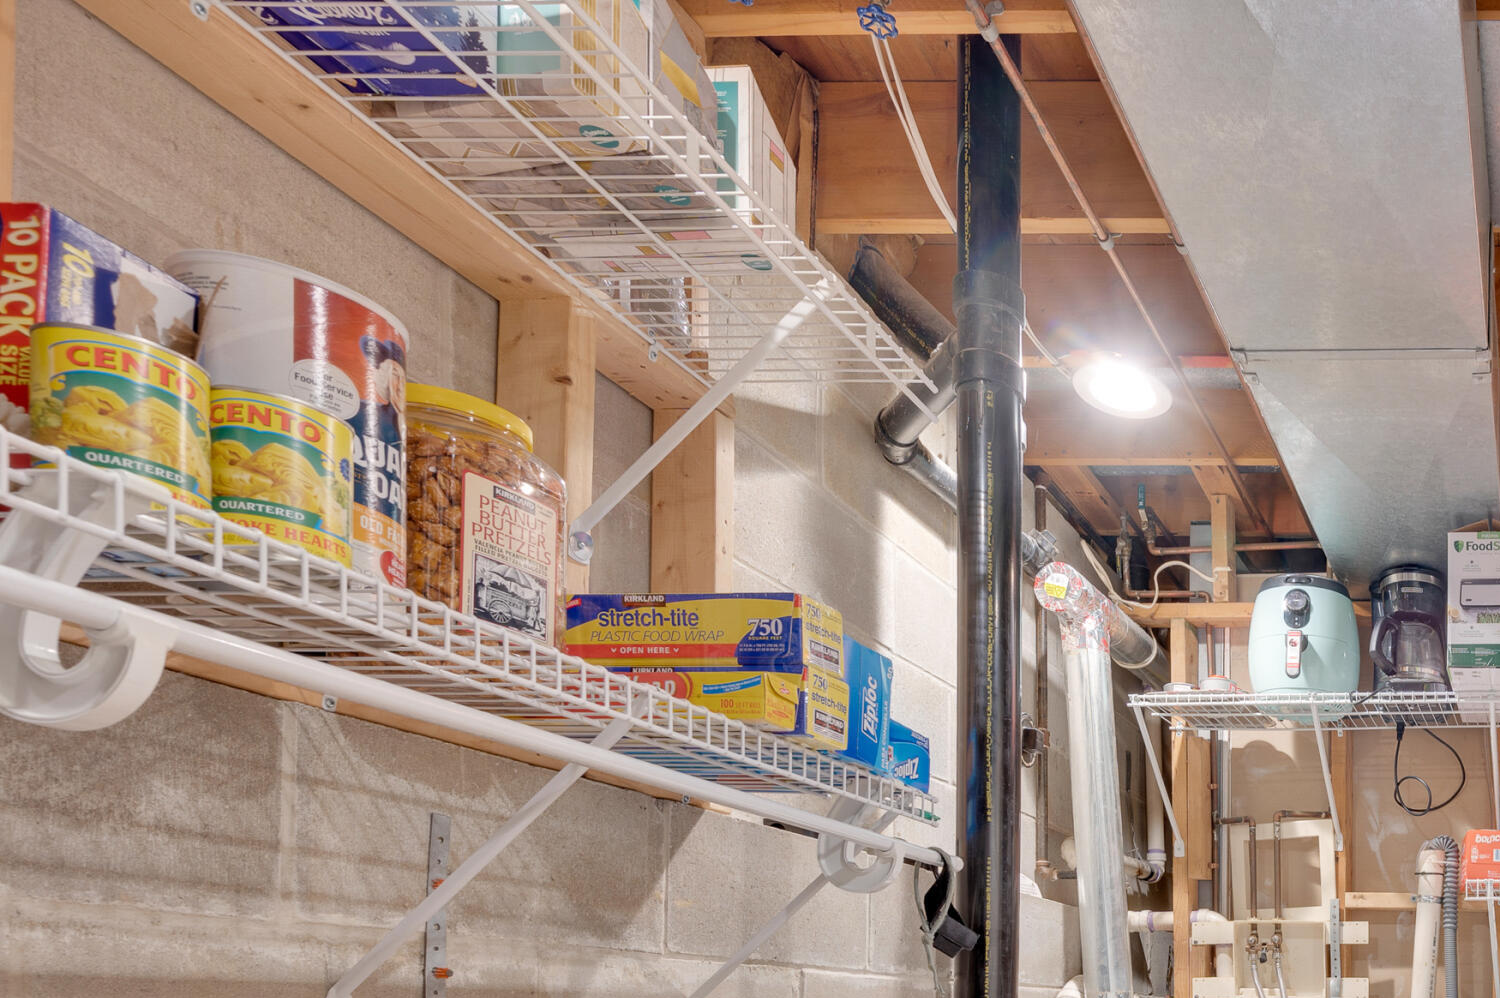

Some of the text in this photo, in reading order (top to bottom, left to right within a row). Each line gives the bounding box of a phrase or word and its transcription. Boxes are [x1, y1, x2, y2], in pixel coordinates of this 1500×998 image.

[0, 215, 40, 342] 10 PACK
[0, 345, 17, 386] SIZE
[66, 345, 196, 400] CENTO
[210, 403, 321, 443] CENTO
[85, 451, 184, 485] QUARTERED
[219, 499, 305, 522] QUARTERED
[494, 487, 536, 511] KIRKLAND
[479, 495, 547, 532] PEANUT
[479, 511, 547, 549] BUTTER
[284, 527, 347, 558] HEARTS
[472, 522, 551, 565] PRETZELS
[623, 595, 665, 603] KIRKLAND
[598, 608, 699, 628] stretch-tite
[805, 604, 821, 619] 750
[590, 630, 725, 641] PLASTIC FOOD WRAP
[748, 618, 783, 636] 750
[805, 622, 841, 643] stretch-tite
[619, 646, 671, 654] OPEN HERE
[813, 674, 828, 690] 750
[811, 691, 847, 714] stretch-tite
[864, 676, 879, 738] Ziploc
[894, 757, 919, 780] Ziploc
